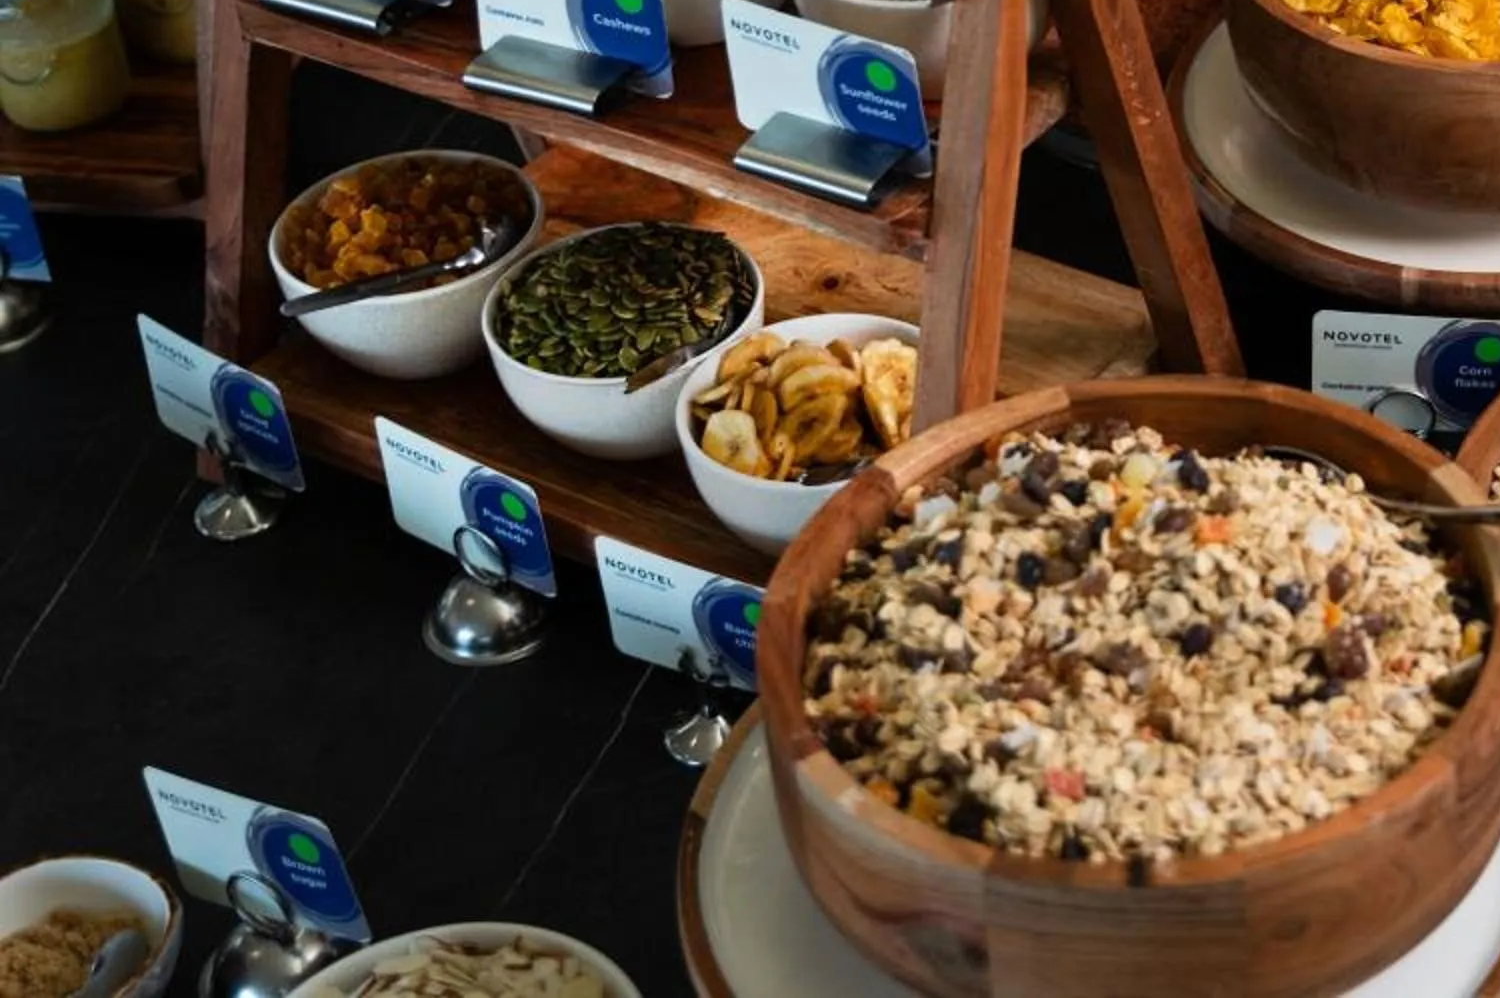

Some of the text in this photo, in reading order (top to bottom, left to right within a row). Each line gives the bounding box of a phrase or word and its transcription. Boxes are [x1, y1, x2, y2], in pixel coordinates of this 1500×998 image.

[592, 13, 652, 37] Cashews
[730, 17, 800, 50] NOVOTEL
[1323, 330, 1403, 345] NOVOTEL
[1458, 365, 1492, 376] Corn
[604, 556, 676, 589] NOVOTEL
[158, 789, 226, 820] NOVOTEL
